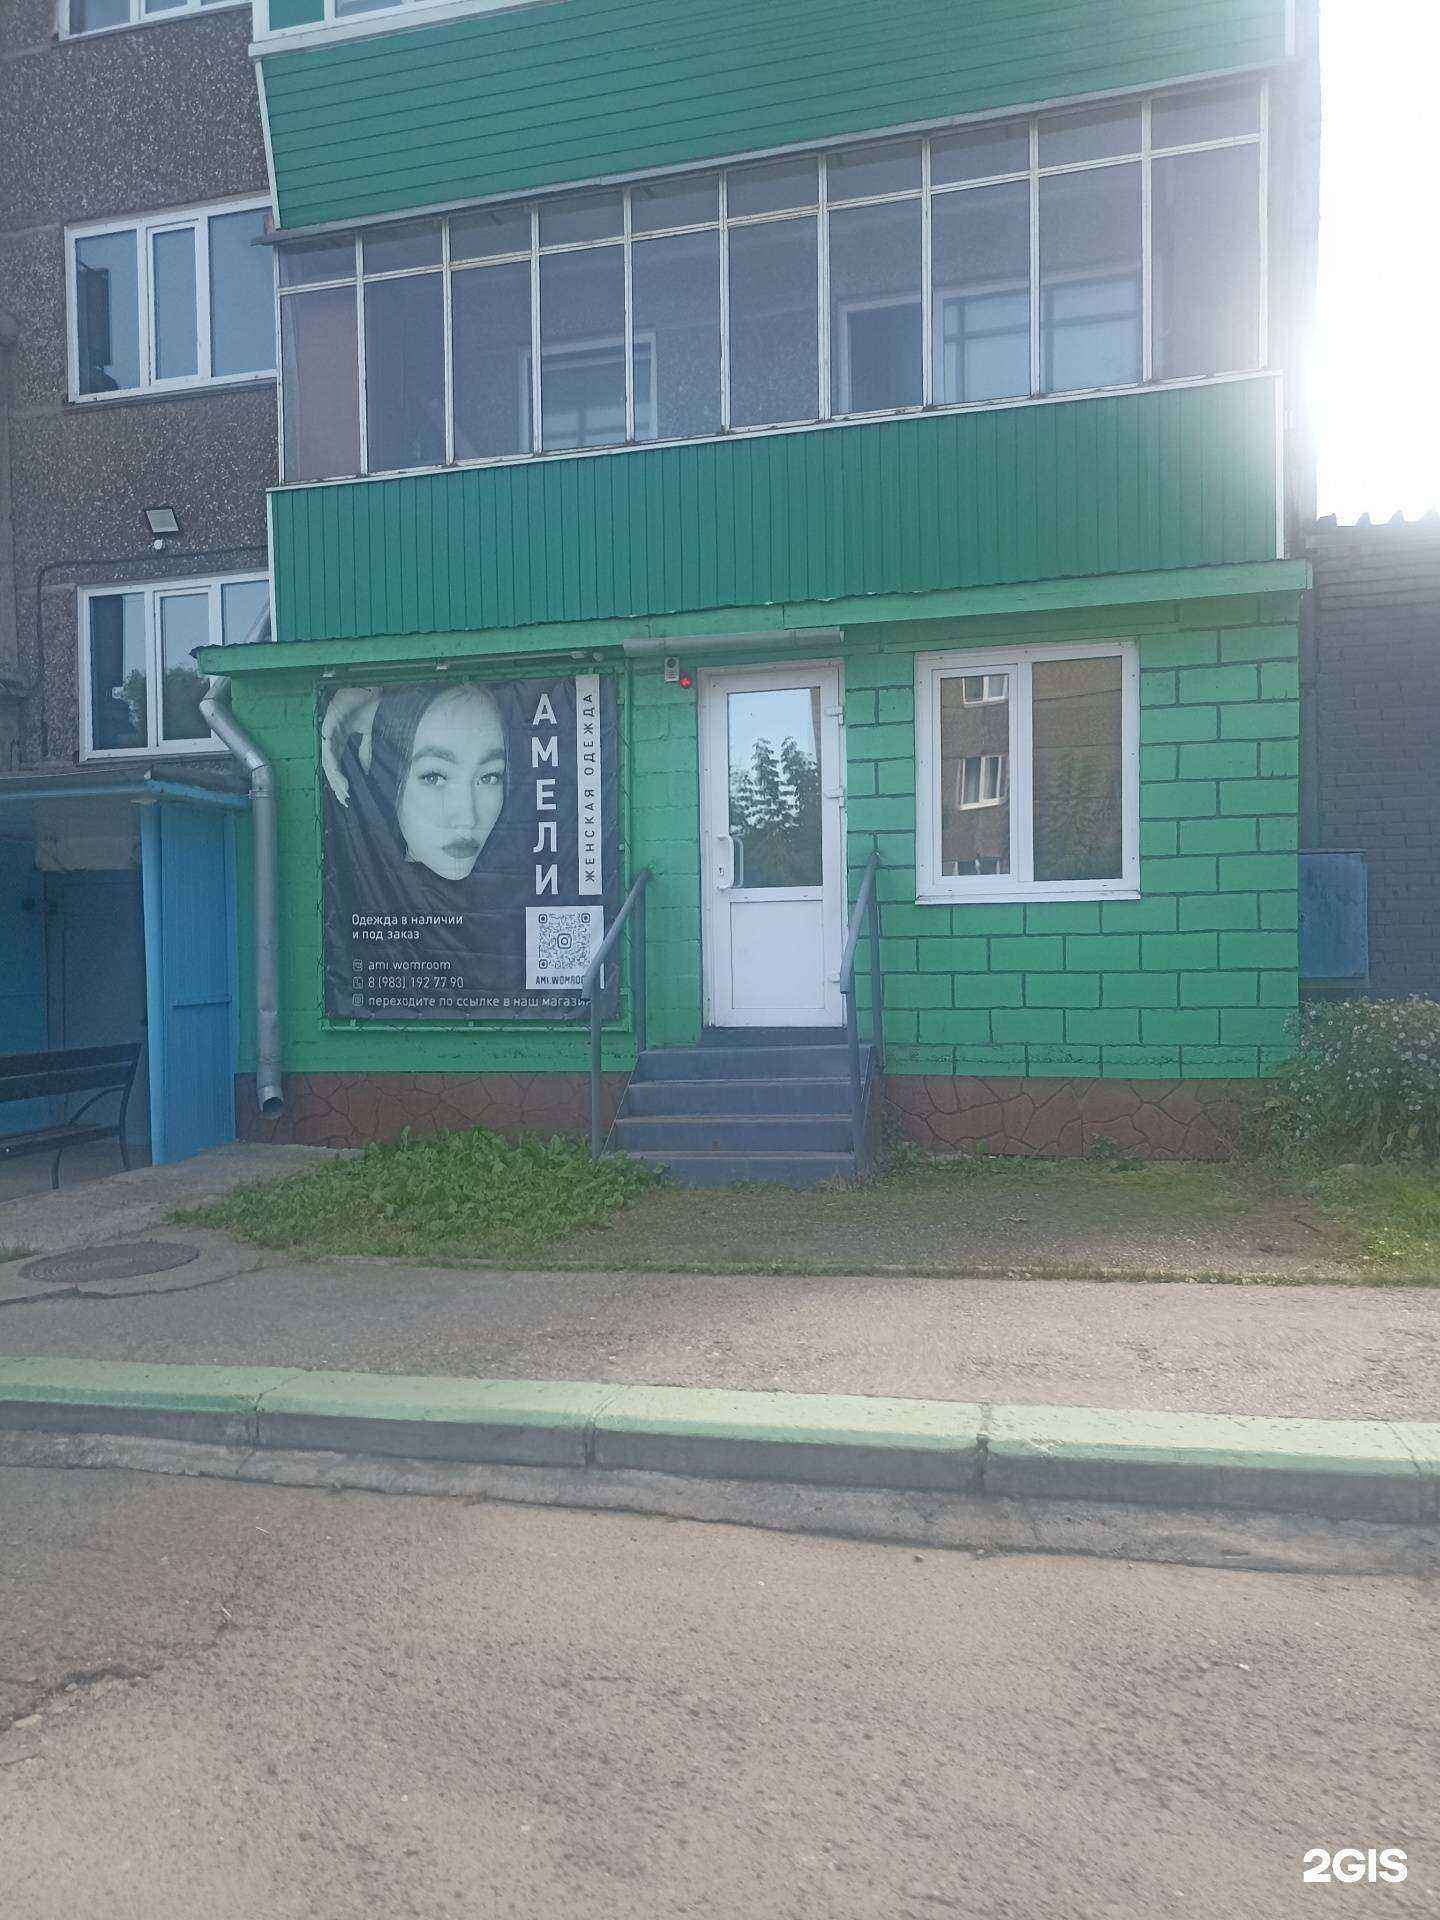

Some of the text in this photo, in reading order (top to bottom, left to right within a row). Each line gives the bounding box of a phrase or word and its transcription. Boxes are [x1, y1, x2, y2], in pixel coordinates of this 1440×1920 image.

[531, 693, 560, 895] АМЕЛИ
[583, 693, 596, 883] ЖЕНСКАЯ ОДЕЖДА
[352, 913, 463, 927] Одежда в наличии
[352, 930, 420, 941] и под заказ
[368, 976, 464, 989] 8 (983) 192 77 90
[535, 975, 585, 985] AMI.WOMROO
[368, 996, 436, 1008] переходите
[440, 997, 453, 1007] по
[456, 997, 500, 1007] ссылке
[503, 997, 511, 1007] в
[513, 997, 539, 1007] наш
